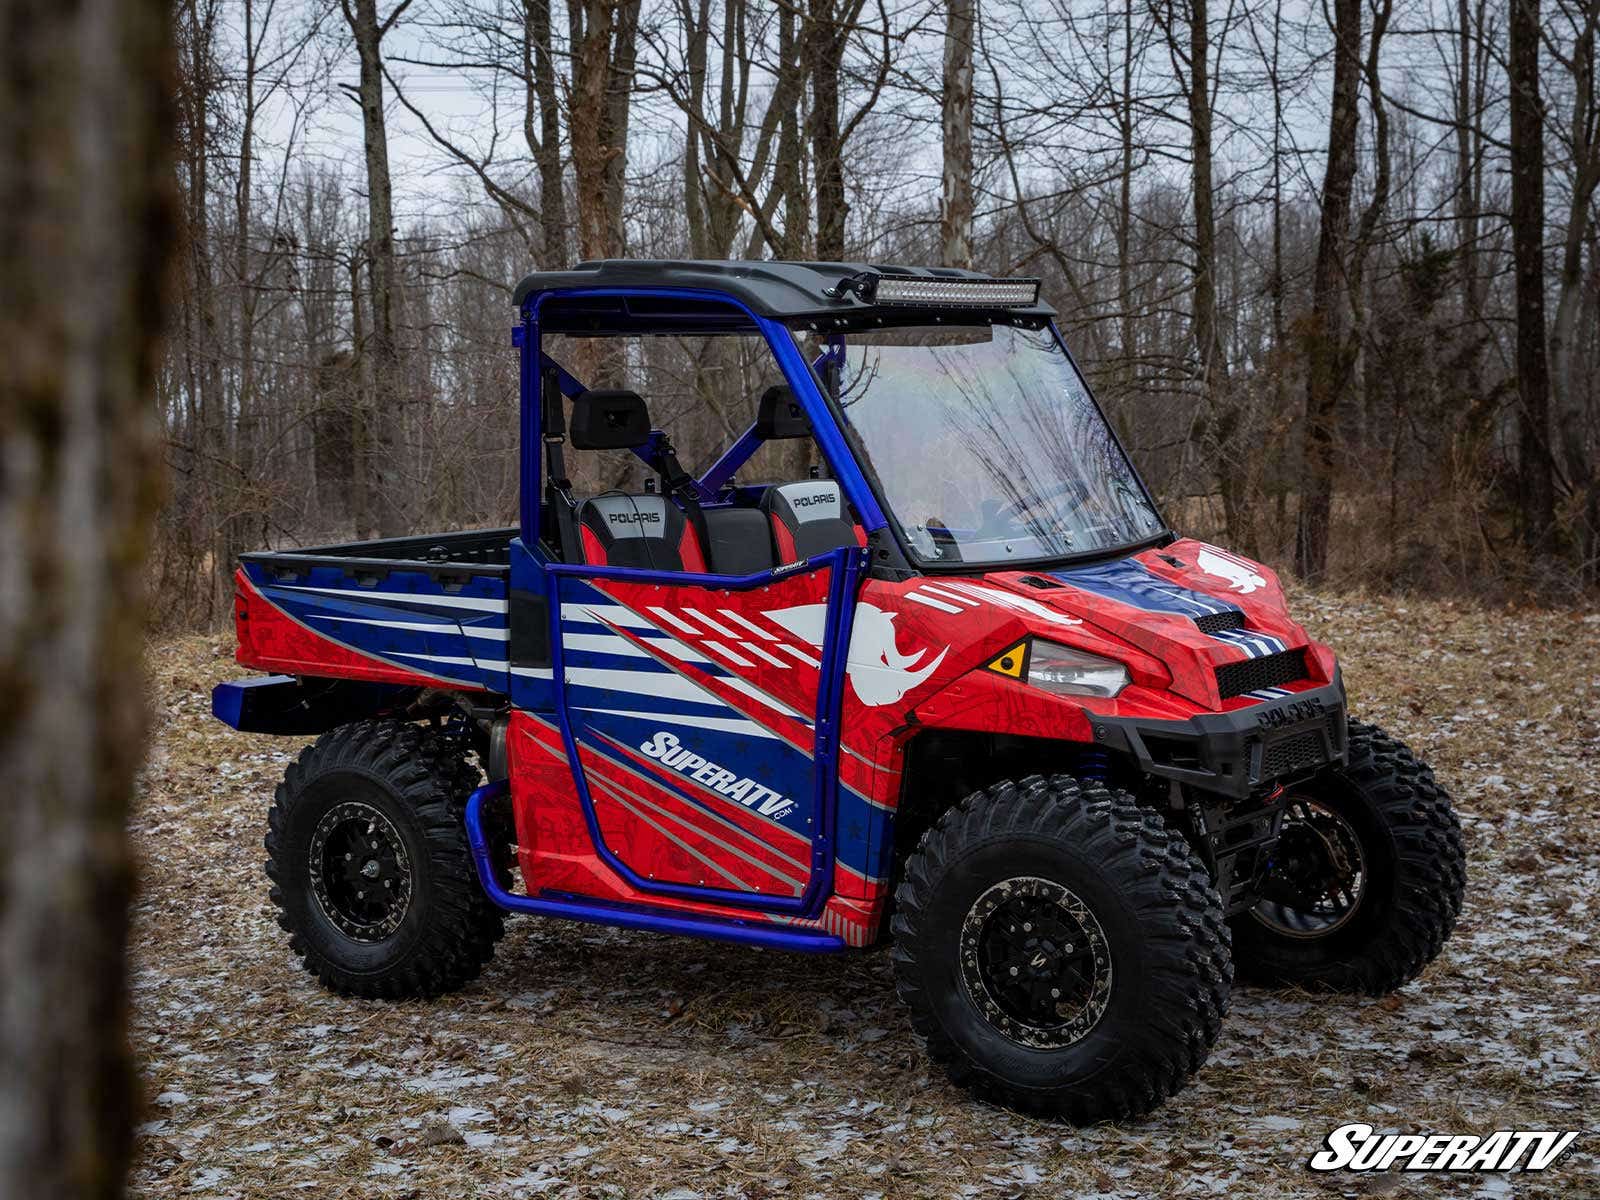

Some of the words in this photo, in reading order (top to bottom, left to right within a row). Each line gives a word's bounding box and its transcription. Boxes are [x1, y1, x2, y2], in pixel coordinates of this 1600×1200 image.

[793, 493, 836, 509] POLARIS
[609, 512, 661, 524] POLARIS
[1256, 697, 1326, 731] POLARIS
